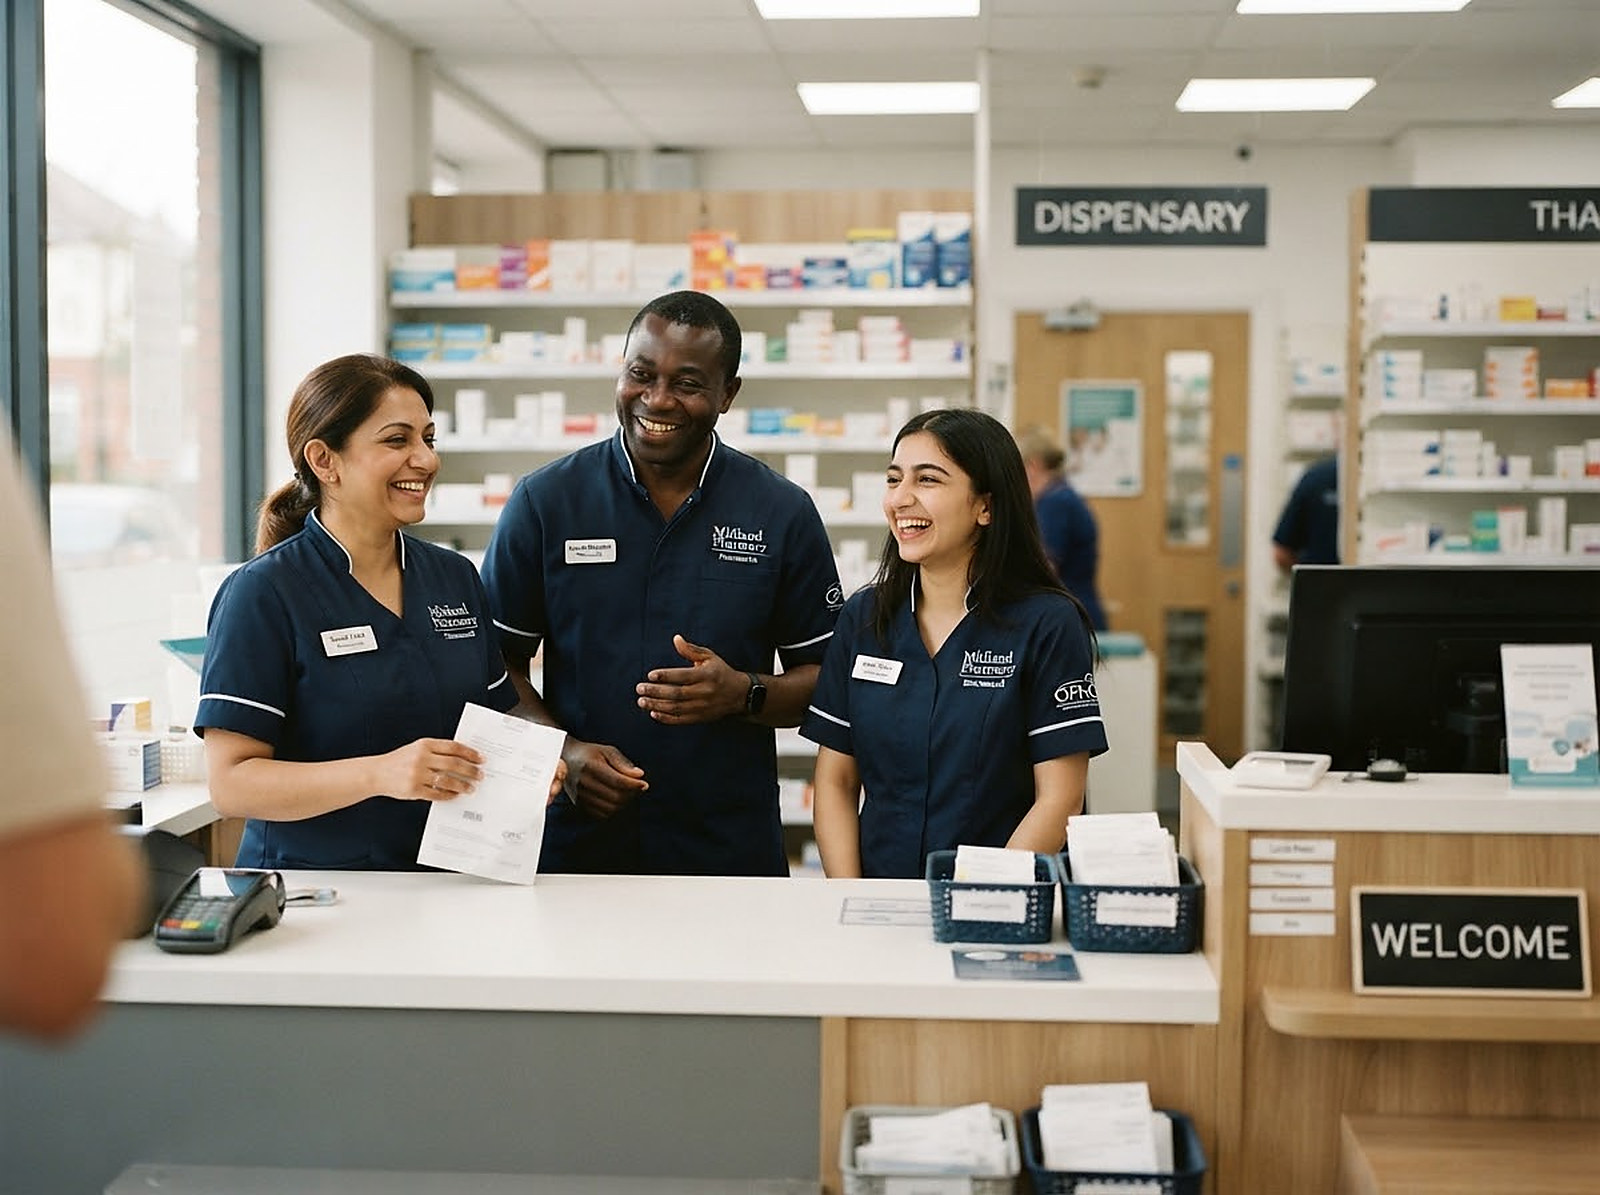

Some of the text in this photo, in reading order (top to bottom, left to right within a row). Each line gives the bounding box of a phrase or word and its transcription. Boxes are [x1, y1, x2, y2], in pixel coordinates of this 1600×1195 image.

[1034, 200, 1249, 233] DISPENSARY
[1529, 200, 1600, 232] THA
[1371, 922, 1571, 960] WELCOME
